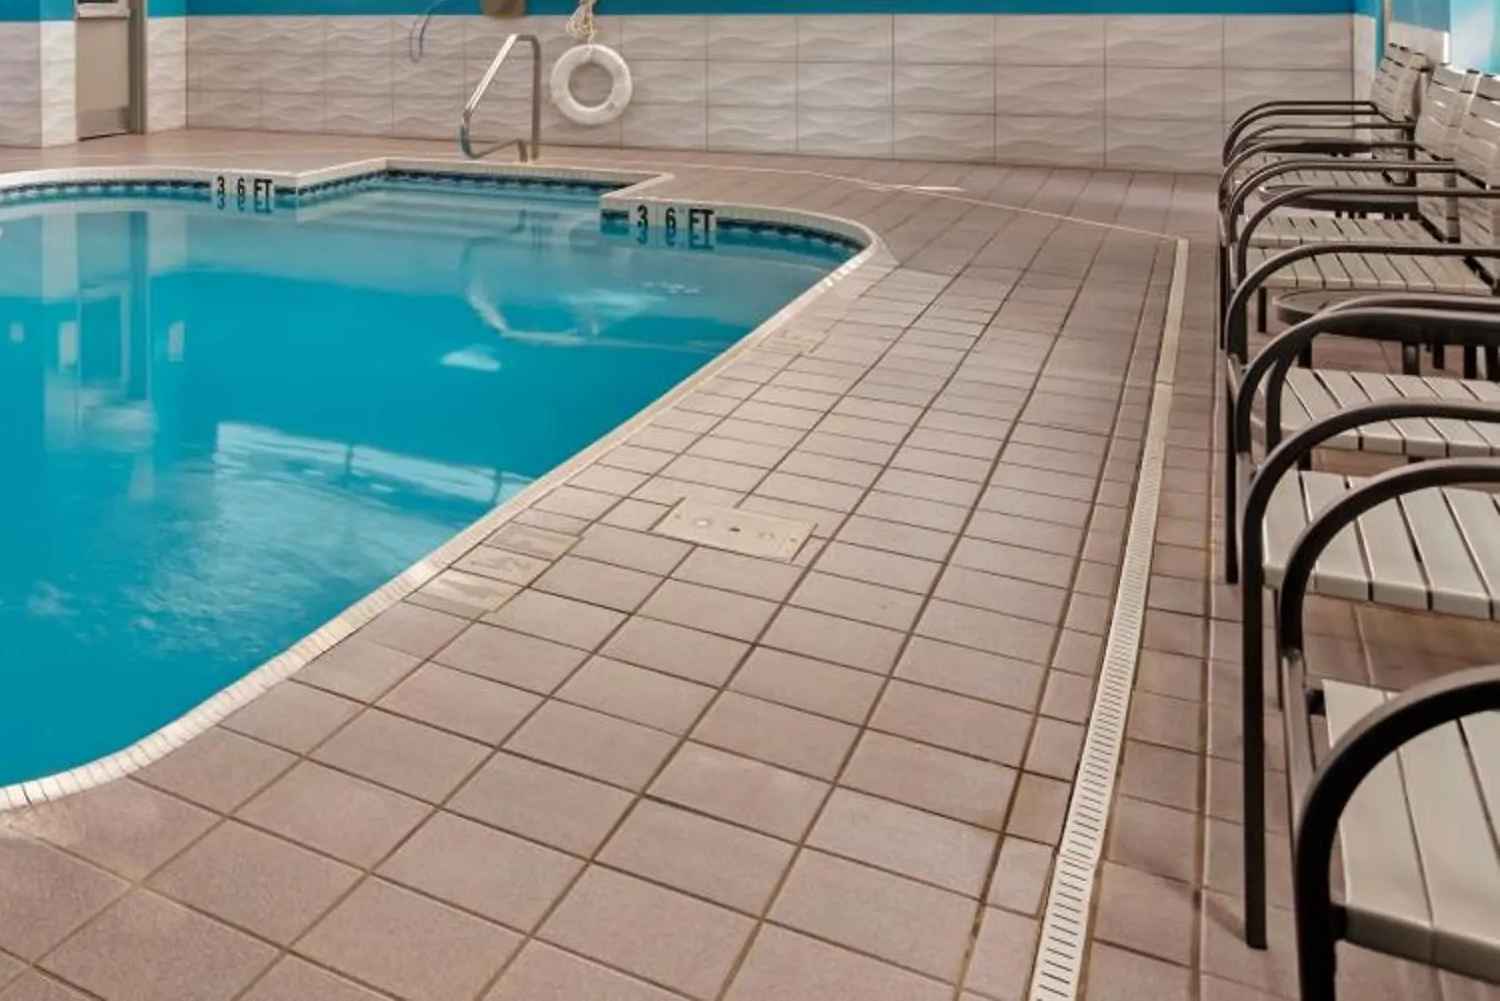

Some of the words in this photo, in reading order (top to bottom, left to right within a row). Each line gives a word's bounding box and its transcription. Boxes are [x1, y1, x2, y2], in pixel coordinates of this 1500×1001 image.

[254, 179, 272, 197] FT
[637, 204, 648, 229] 3
[666, 207, 676, 229] 6
[689, 208, 714, 231] FT
